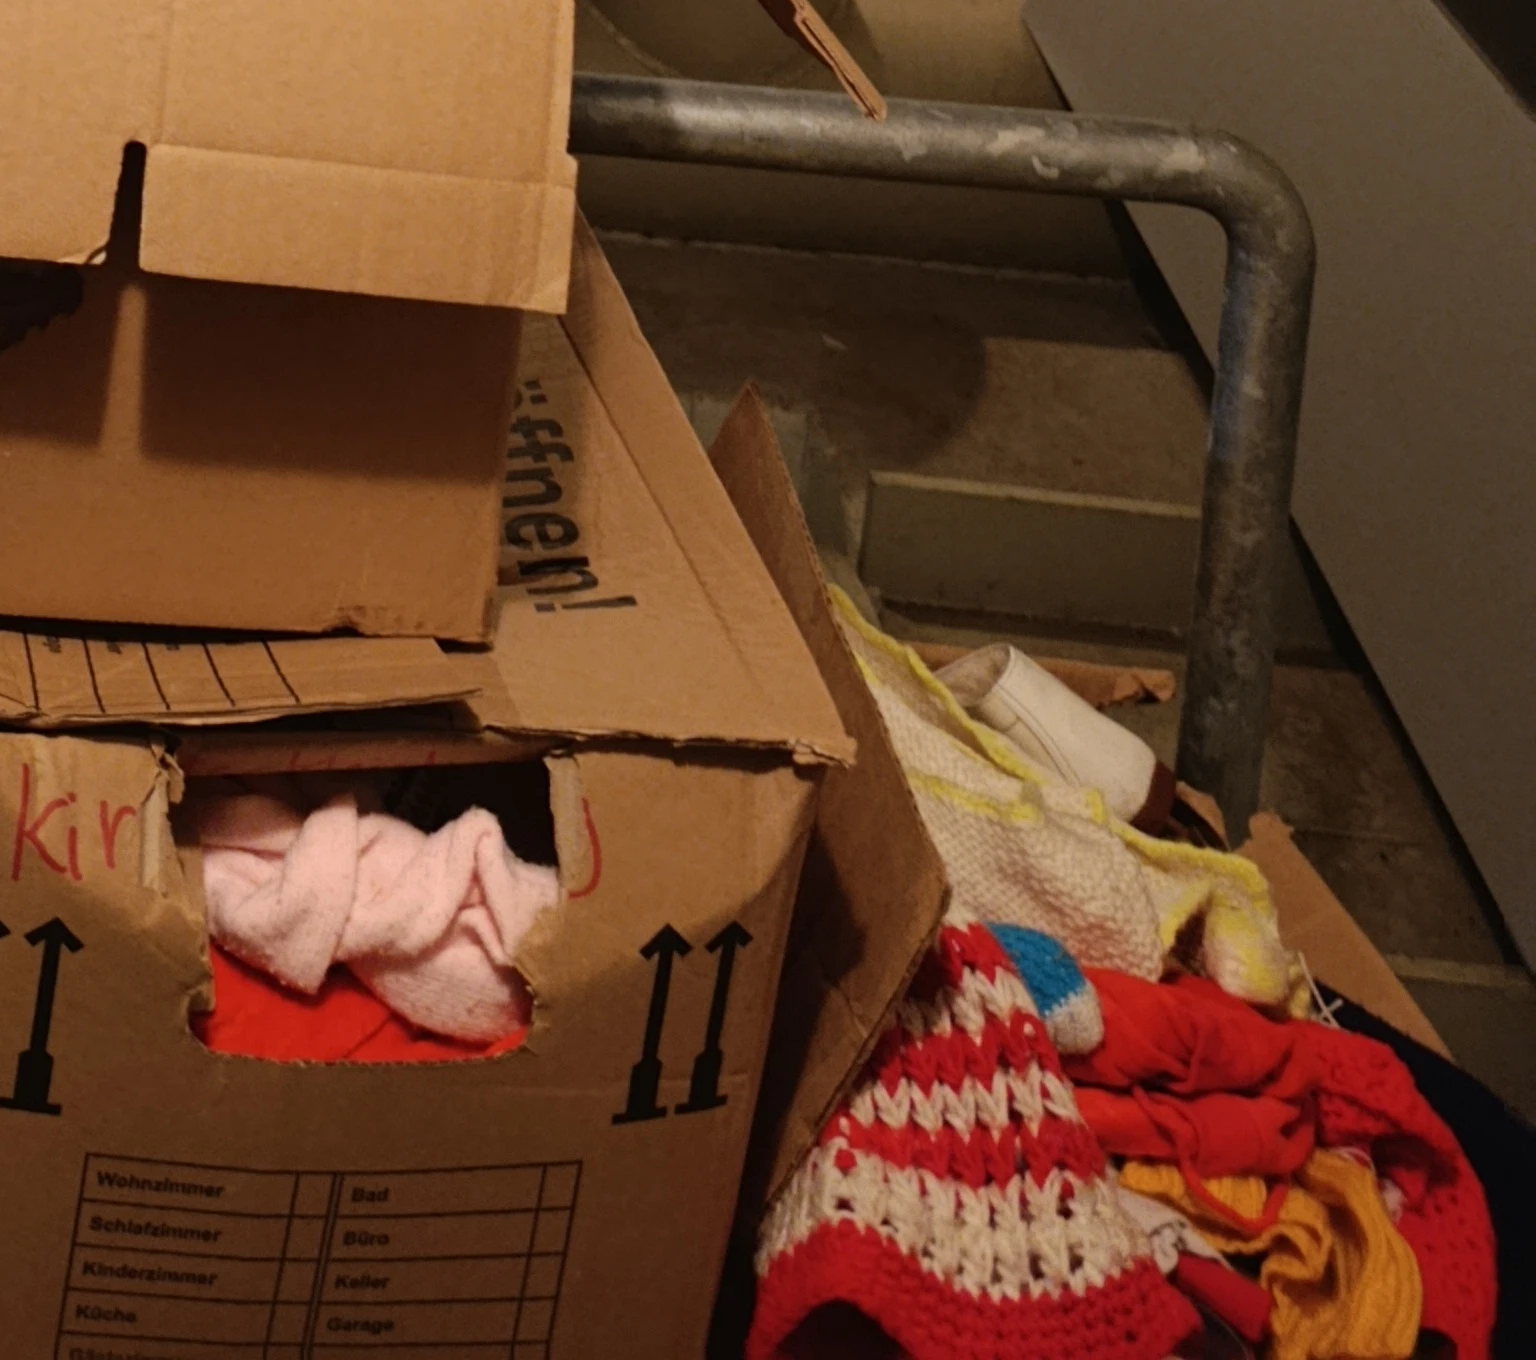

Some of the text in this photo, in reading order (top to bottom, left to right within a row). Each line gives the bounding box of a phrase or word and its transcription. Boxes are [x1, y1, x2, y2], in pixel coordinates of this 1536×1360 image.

[96, 1170, 226, 1198] Wohnzimmer
[351, 1186, 389, 1203] Bad
[89, 1216, 222, 1243] Schlafzimmer
[343, 1230, 390, 1247] Büro
[82, 1260, 218, 1287] Kinderzimmer
[75, 1304, 137, 1324] Küche
[326, 1316, 395, 1335] Garage
